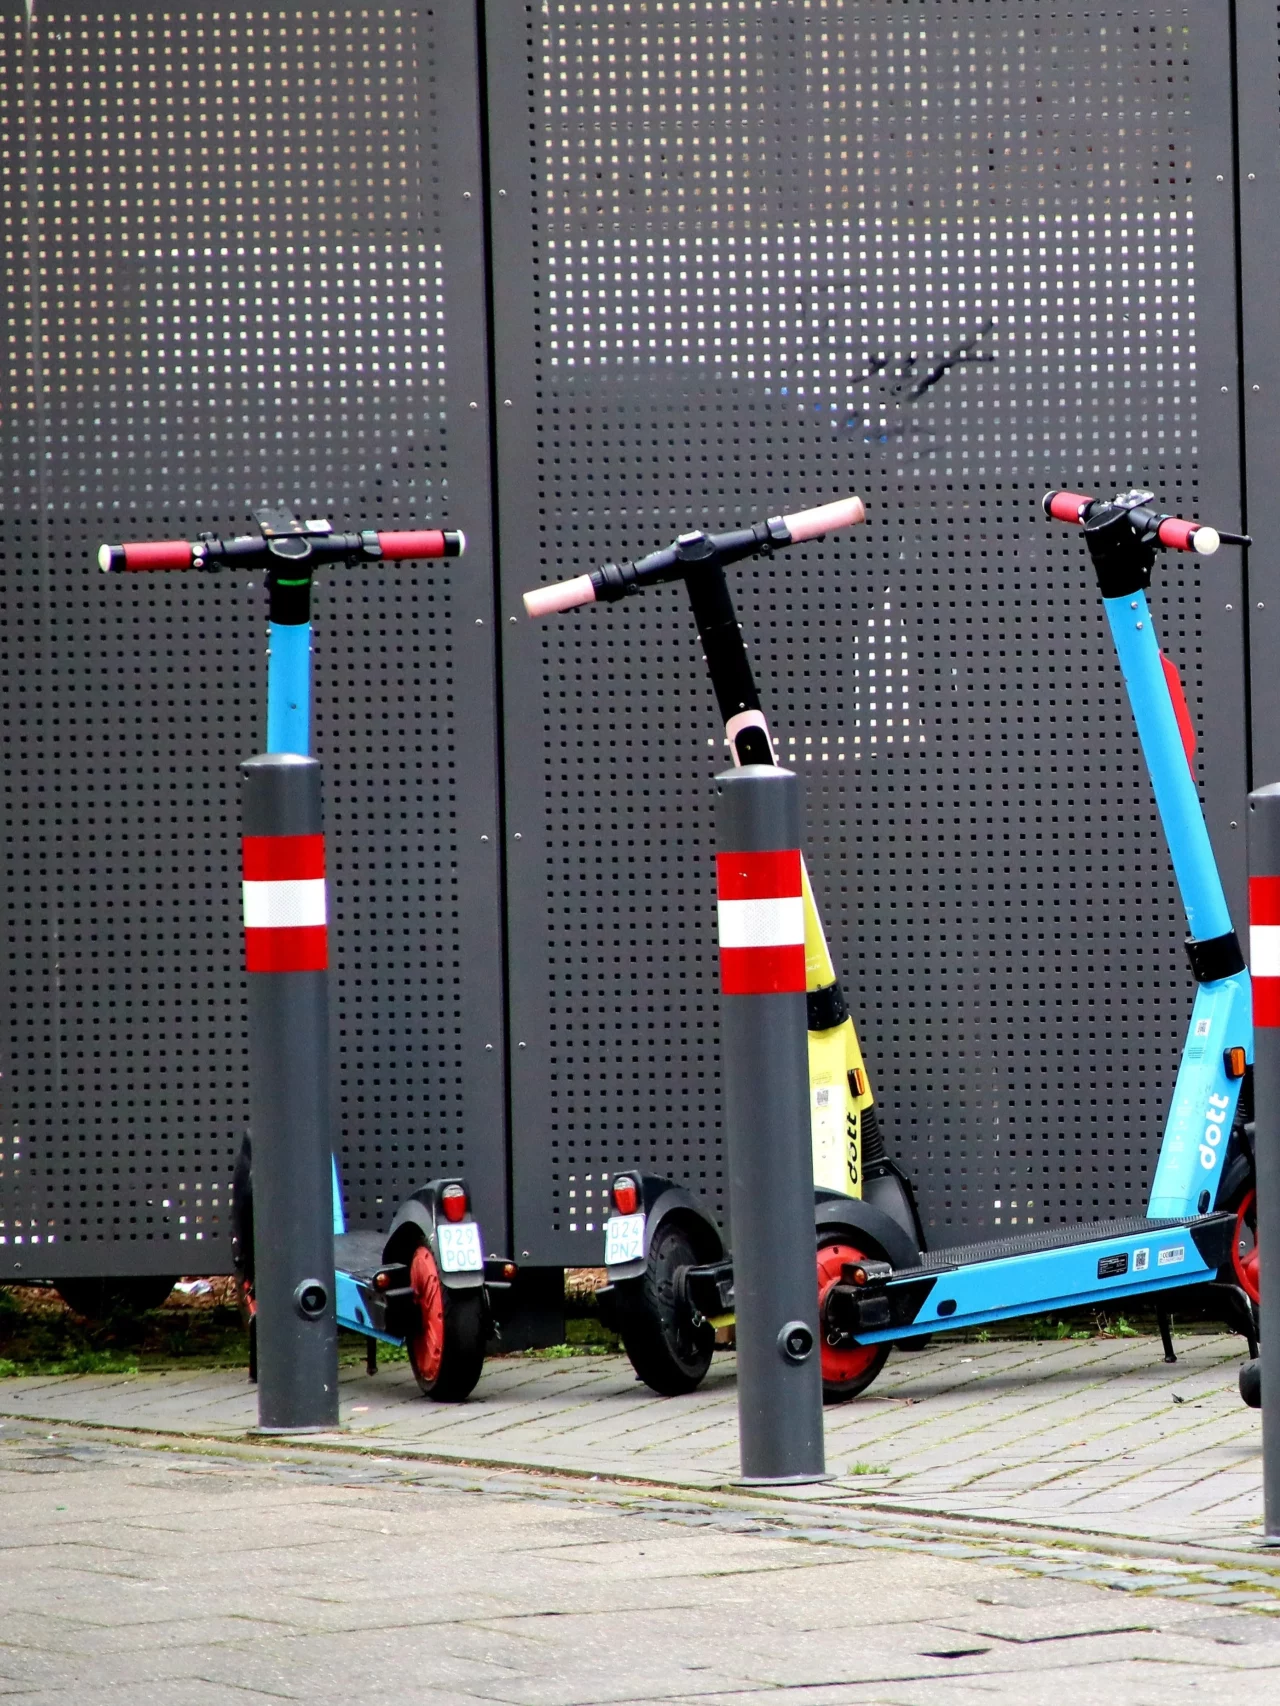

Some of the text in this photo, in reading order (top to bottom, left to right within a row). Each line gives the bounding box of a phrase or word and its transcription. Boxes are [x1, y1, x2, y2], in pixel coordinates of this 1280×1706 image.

[1198, 1092, 1230, 1170] dott
[443, 1228, 474, 1247] 929
[610, 1240, 639, 1261] PNZ
